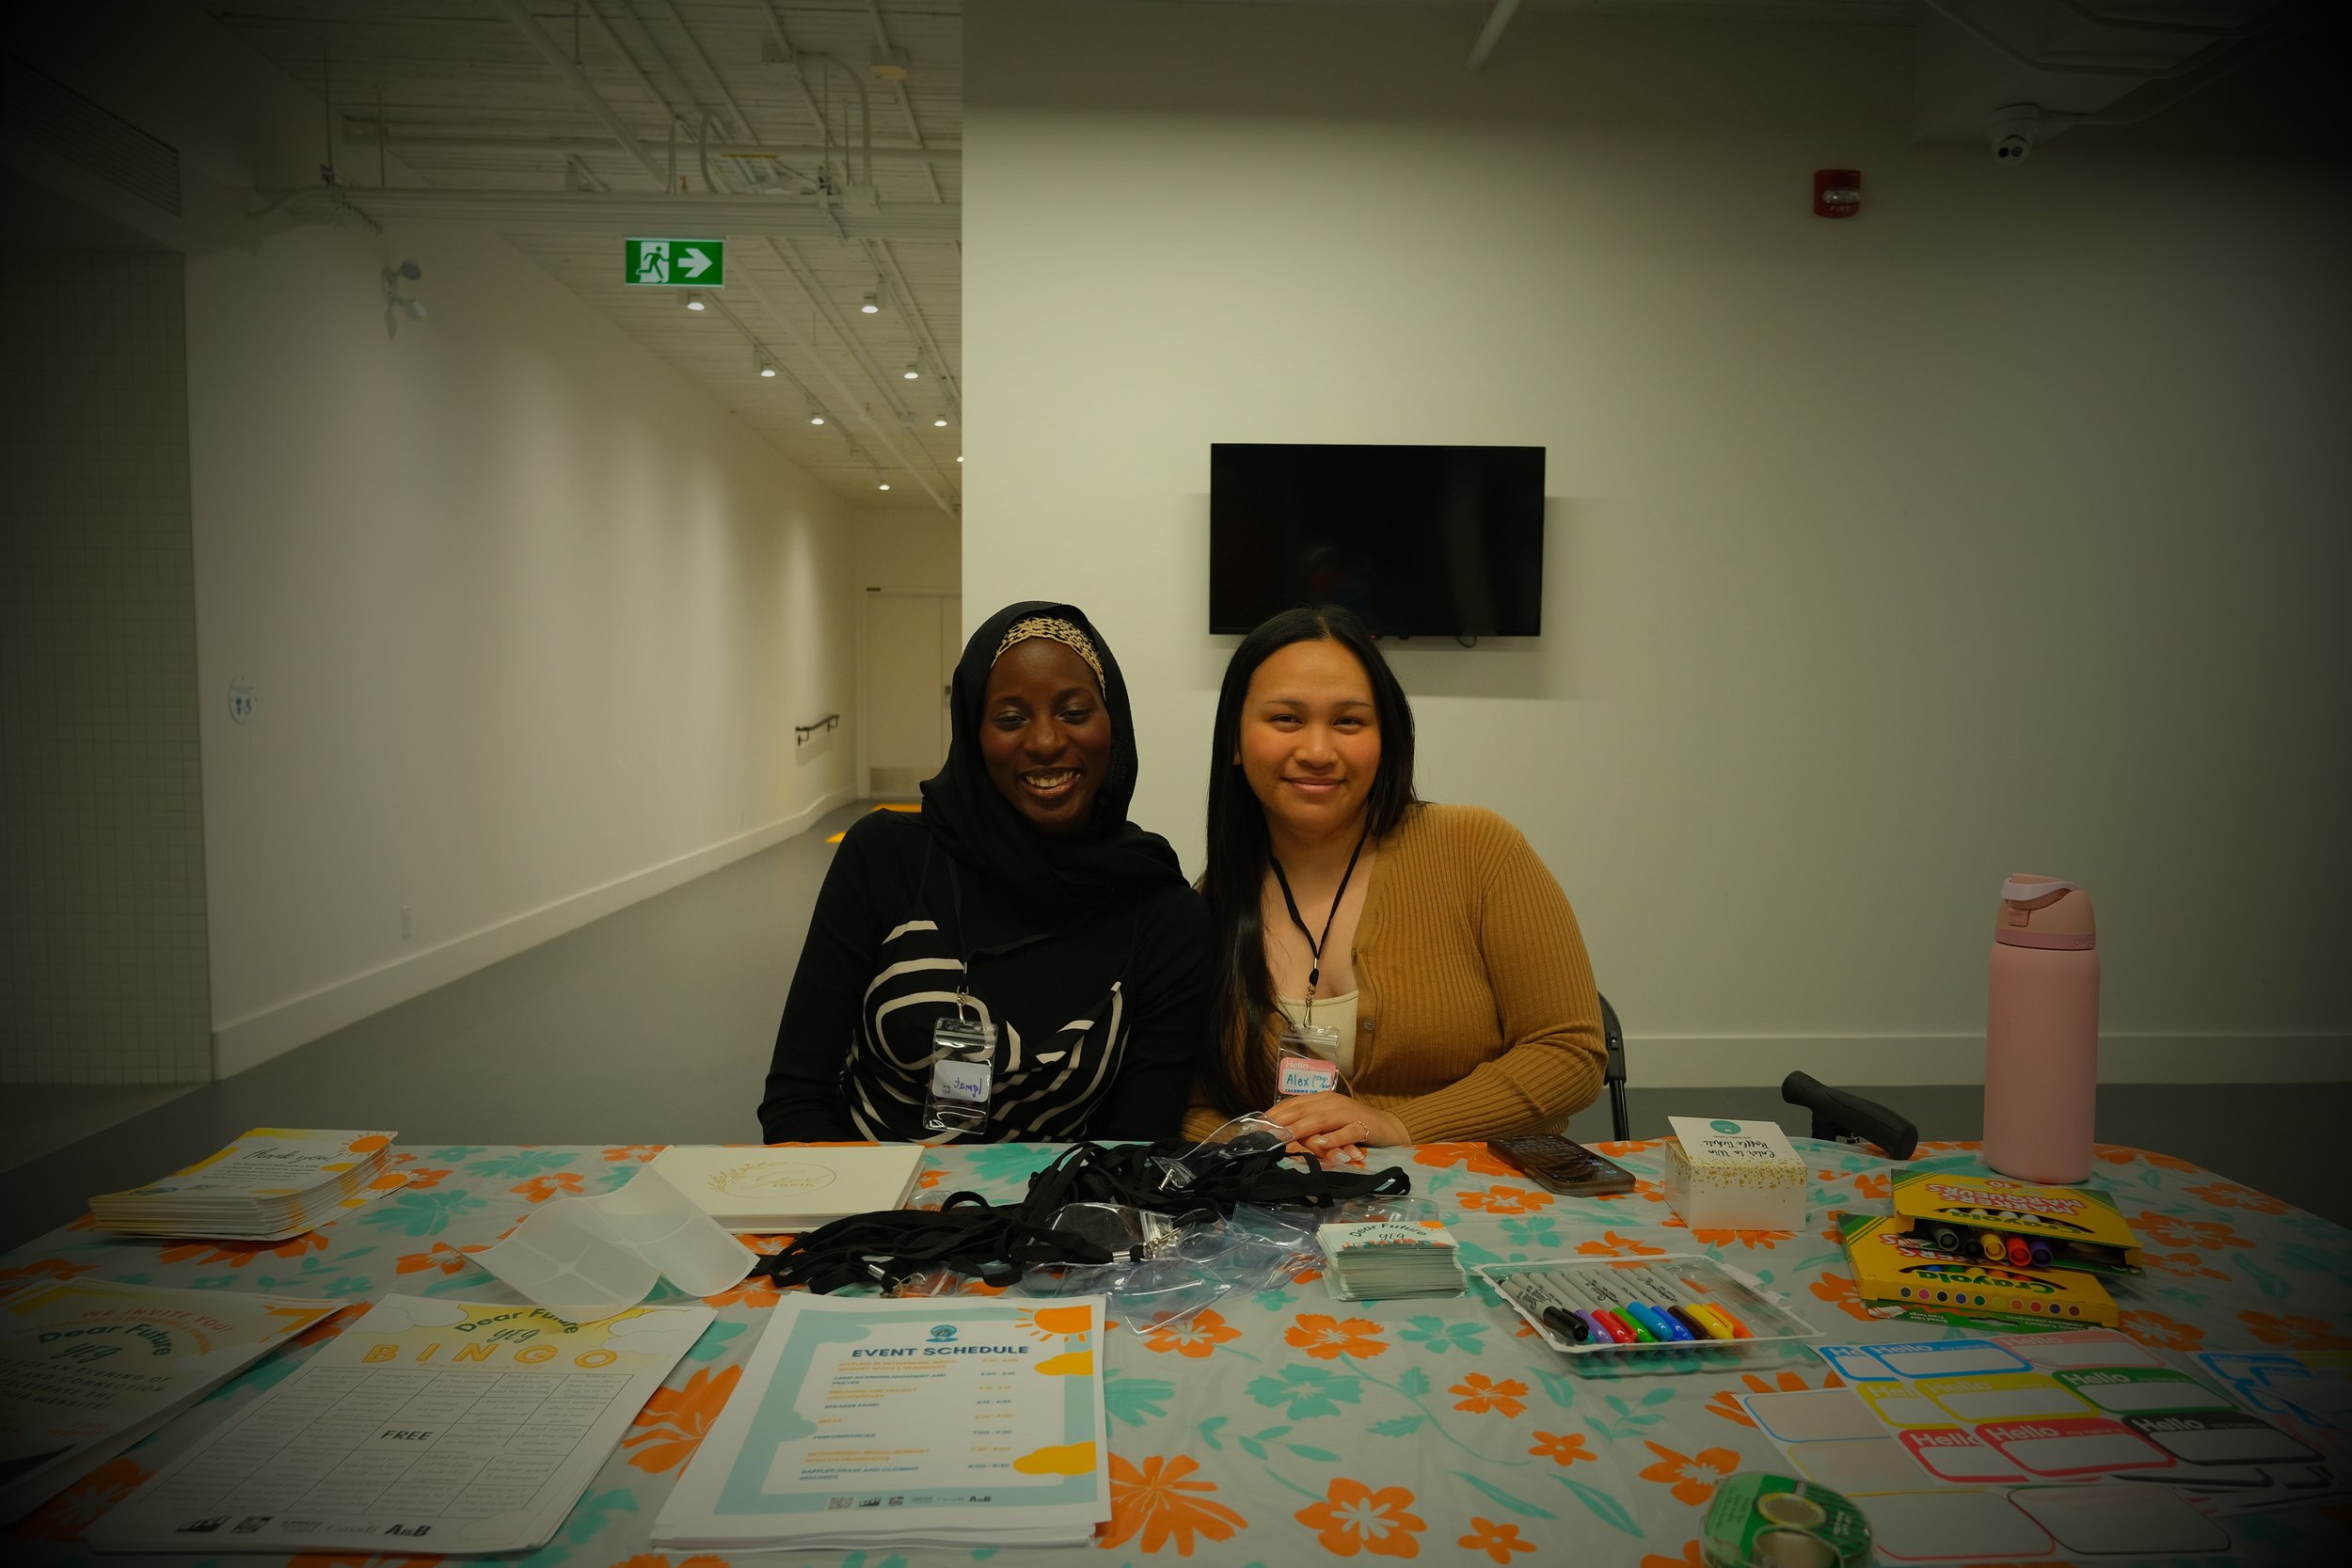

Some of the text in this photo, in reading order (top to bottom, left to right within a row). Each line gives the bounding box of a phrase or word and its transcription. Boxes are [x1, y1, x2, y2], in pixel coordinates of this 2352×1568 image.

[1286, 1060, 1309, 1070] Hello
[1286, 1073, 1310, 1087] Alex
[1739, 1139, 1770, 1149] Raffle
[1707, 1149, 1775, 1159] Enter to Win
[1925, 1183, 2088, 1210] MARQUEURS
[1939, 1193, 2079, 1217] MARKERS
[1950, 1211, 2085, 1235] Crayola
[1349, 1225, 1376, 1238] Dear
[1912, 1269, 2057, 1295] Crayola
[122, 1308, 194, 1319] INVITE
[454, 1309, 524, 1333] Dear
[38, 1324, 124, 1343] Dear
[123, 1323, 174, 1355] Future
[1998, 1337, 2063, 1348] Hello
[361, 1343, 618, 1369] BINGO
[851, 1345, 1030, 1358] EVENT SCHEDULE
[1868, 1343, 1934, 1355] Hello
[74, 1368, 150, 1380] EVENING
[2061, 1371, 2131, 1386] Hello
[58, 1376, 167, 1391] CONNECTION
[1867, 1383, 1921, 1399] Hel
[1923, 1380, 1992, 1395] Hello
[32, 1396, 115, 1408] WEBSITE!
[2130, 1417, 2206, 1432] Hello
[379, 1430, 434, 1441] FREE
[1987, 1425, 2058, 1443] Hello
